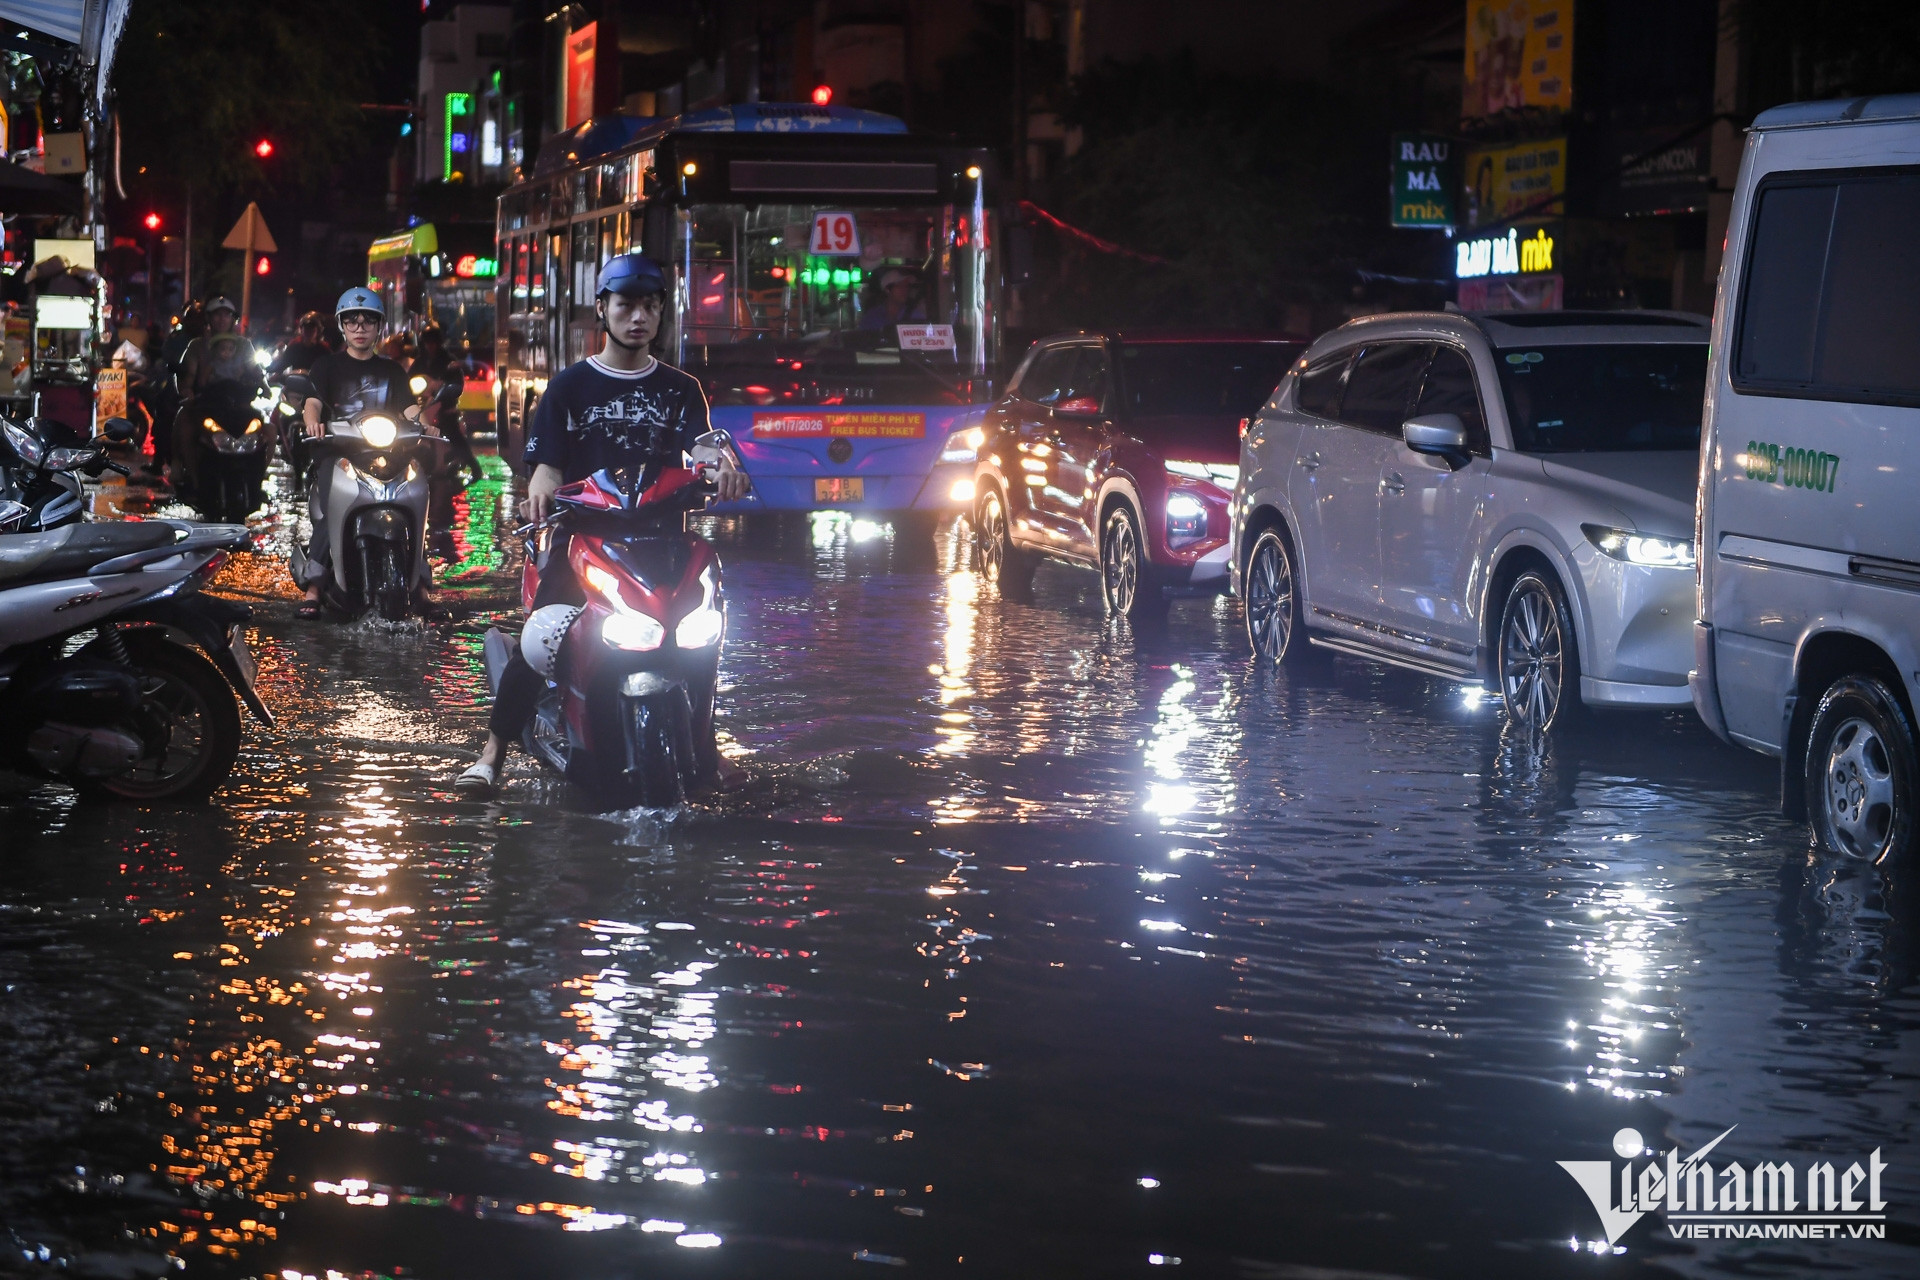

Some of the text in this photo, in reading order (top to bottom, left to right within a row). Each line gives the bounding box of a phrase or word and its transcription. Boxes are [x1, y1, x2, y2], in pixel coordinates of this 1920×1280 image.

[1400, 141, 1448, 163] RAU
[1406, 165, 1442, 192] MÁ
[1401, 199, 1447, 221] mix
[816, 216, 853, 251] 19
[1456, 227, 1554, 279] RAU MÁ mix
[903, 328, 933, 337] HƯỚN
[774, 419, 823, 432] 01/7/2026
[830, 426, 915, 436] FREE BUS TICKET
